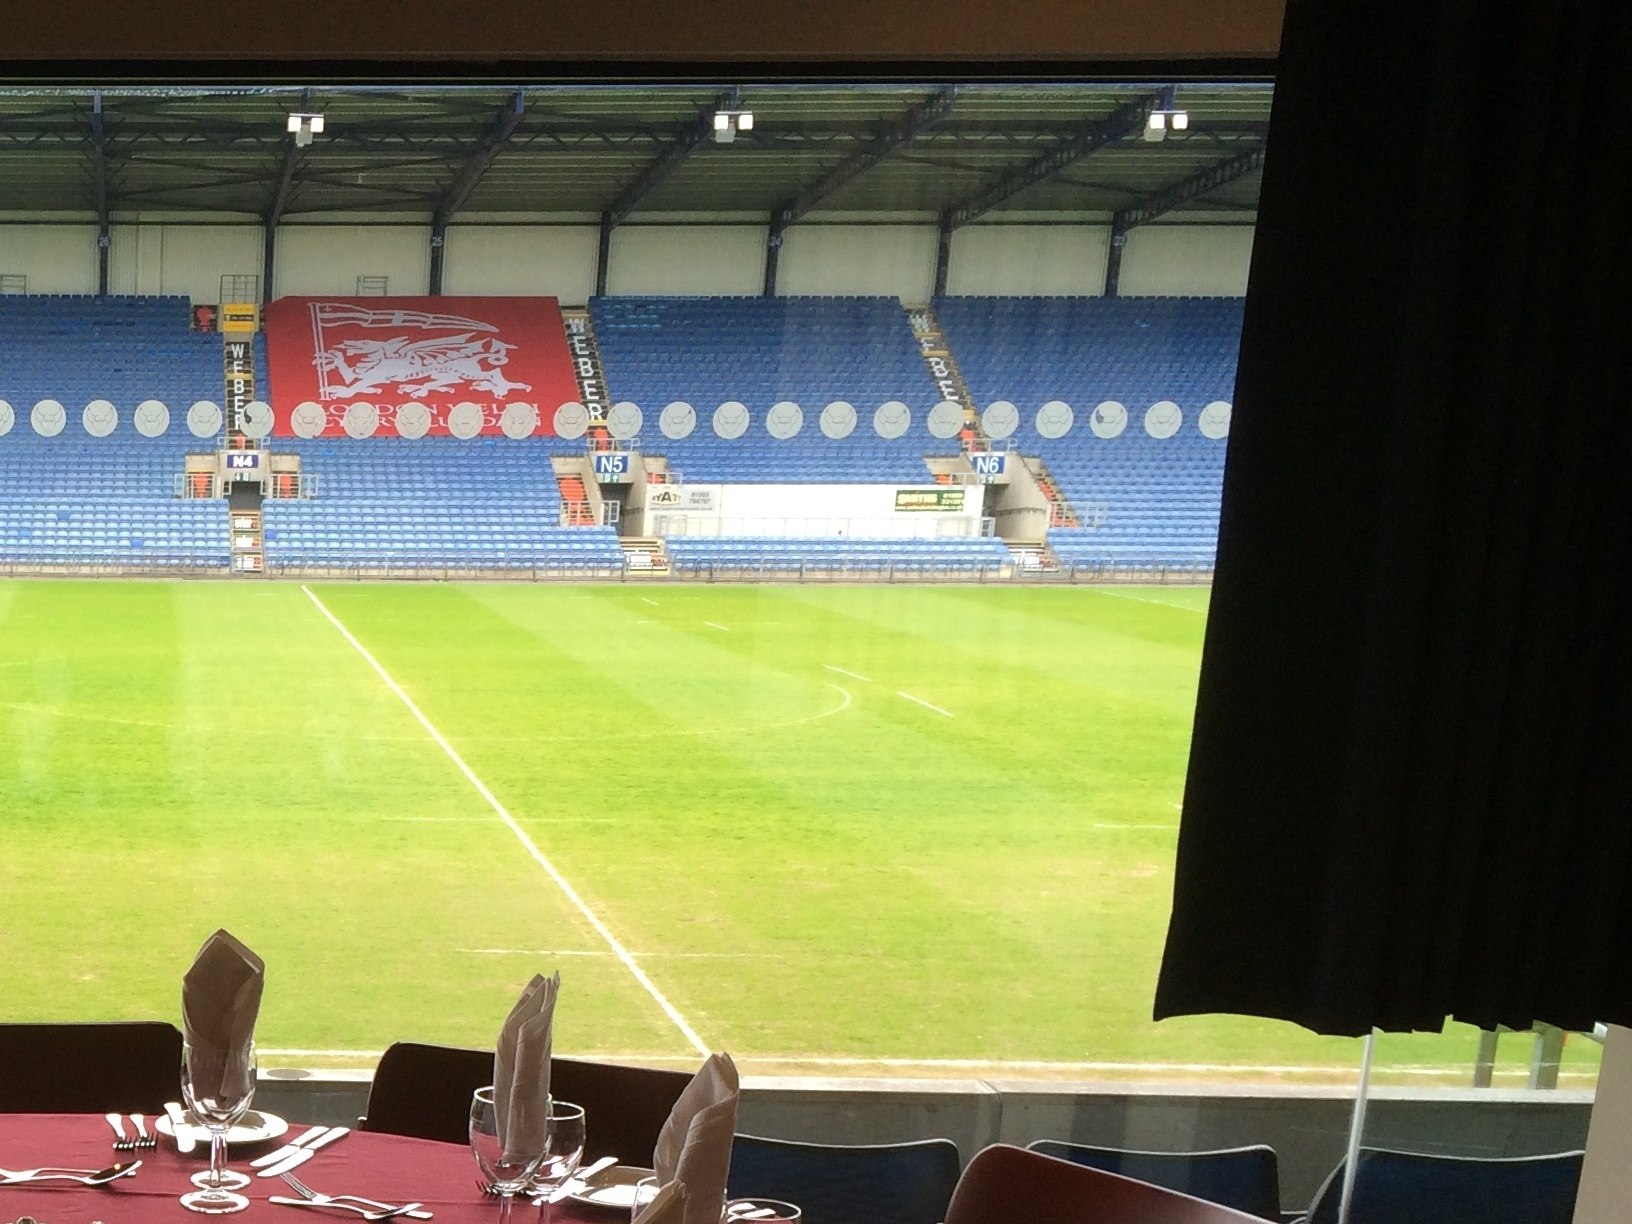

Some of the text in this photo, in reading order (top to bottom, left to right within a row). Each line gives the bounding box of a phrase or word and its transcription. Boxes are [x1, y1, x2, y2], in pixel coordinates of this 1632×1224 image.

[431, 236, 443, 246] 25
[909, 313, 959, 400] WEBE
[569, 318, 603, 421] WEBER
[232, 455, 253, 467] N4
[600, 456, 623, 473] N5
[976, 456, 999, 473] N6
